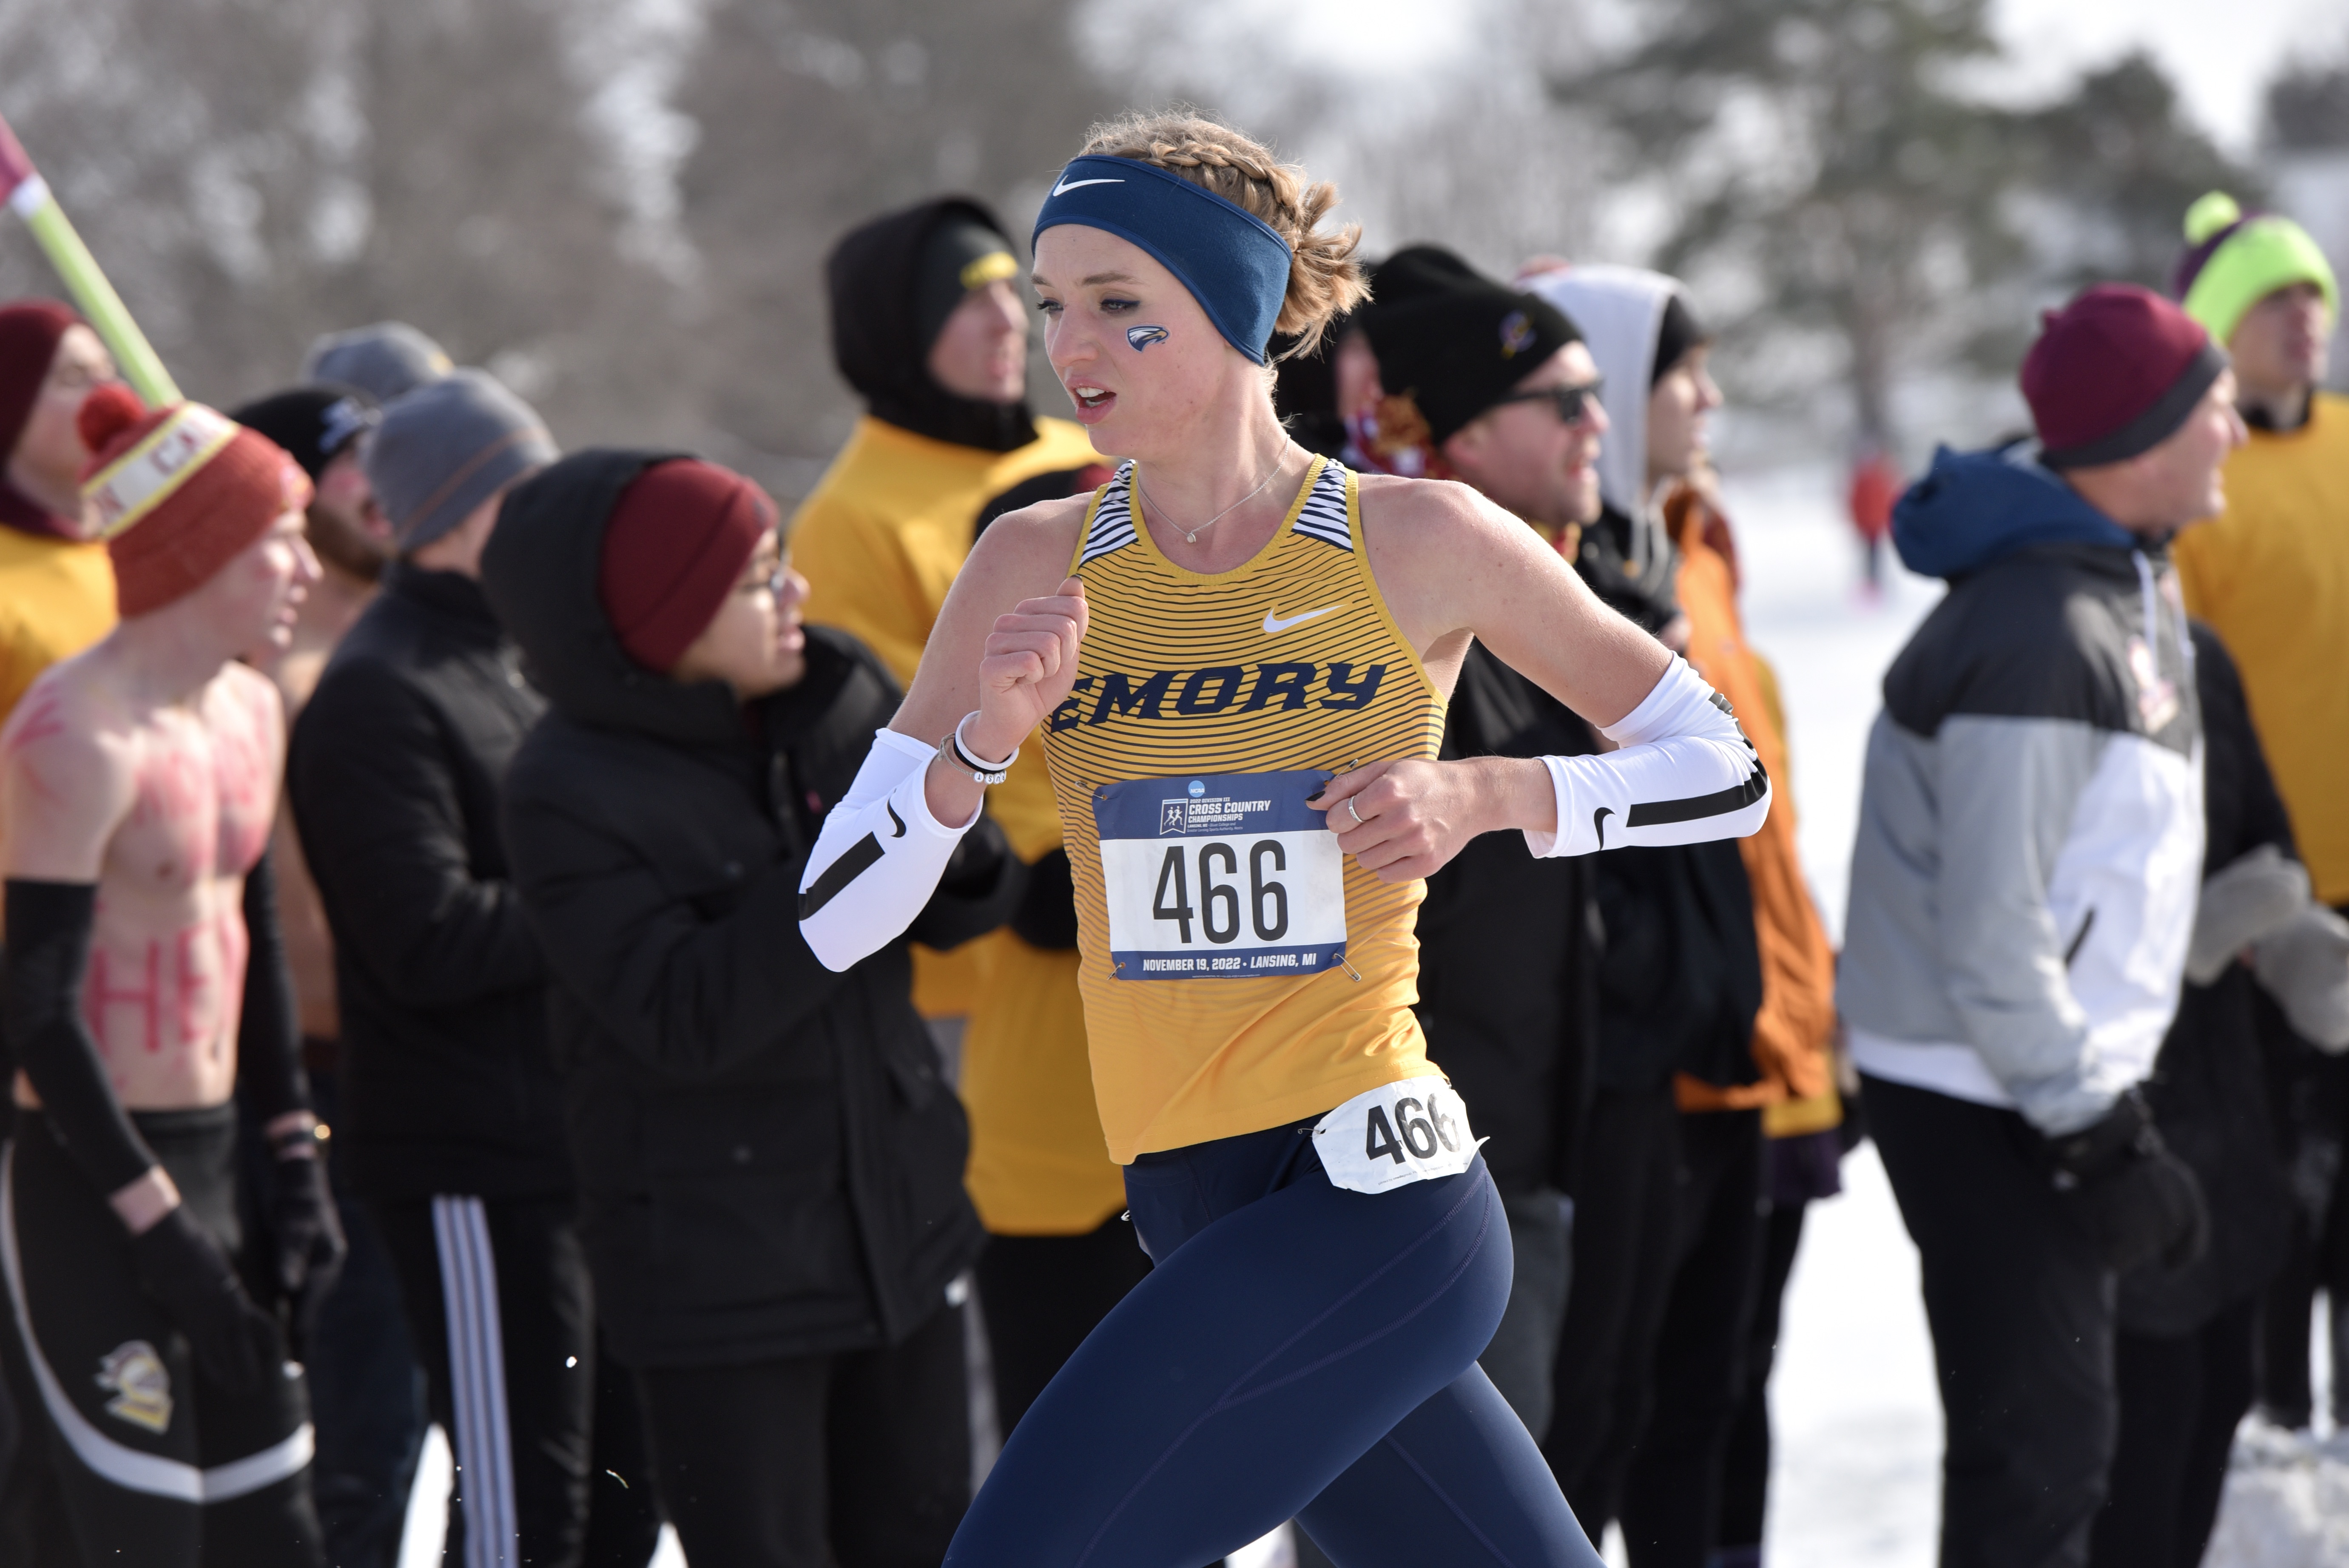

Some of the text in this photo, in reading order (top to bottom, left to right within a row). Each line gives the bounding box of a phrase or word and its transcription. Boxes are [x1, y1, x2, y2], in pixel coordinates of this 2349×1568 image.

[1051, 662, 1387, 733] EMORY
[1188, 813, 1243, 823] CHAMPIONSHIPS
[1189, 800, 1271, 815] CROSS COUNTRY
[1153, 840, 1288, 943] 466
[1143, 953, 1317, 971] NOVEMBER 19, 2022 LANSING, MI
[1365, 1093, 1461, 1165] 466
